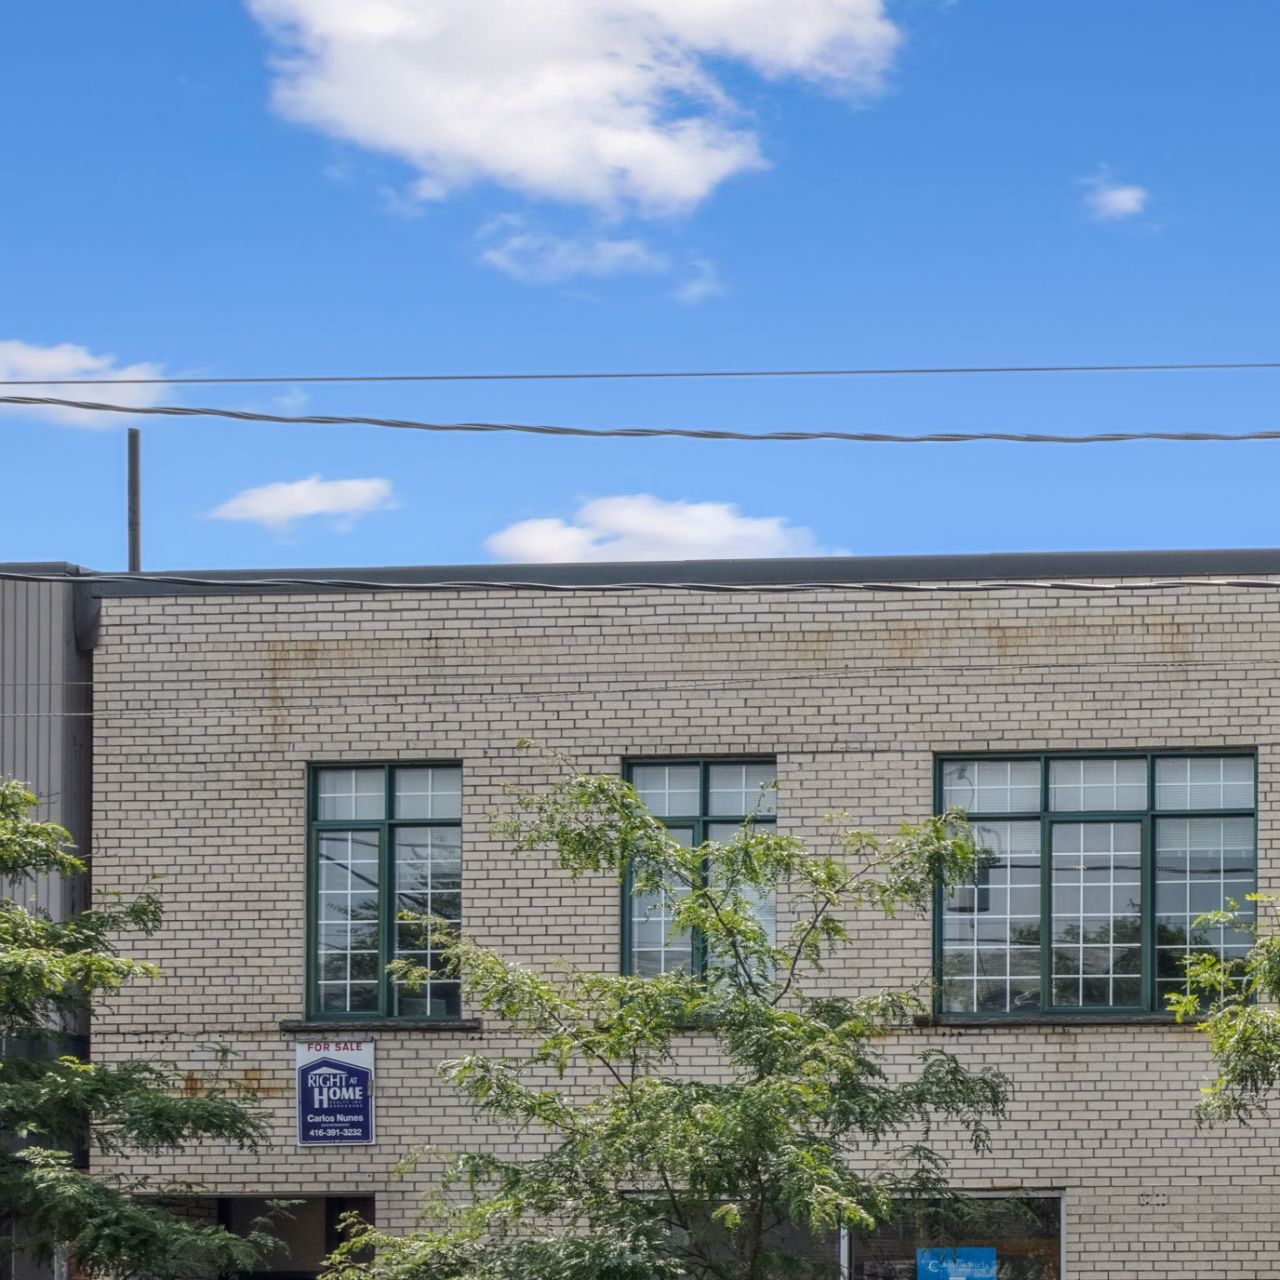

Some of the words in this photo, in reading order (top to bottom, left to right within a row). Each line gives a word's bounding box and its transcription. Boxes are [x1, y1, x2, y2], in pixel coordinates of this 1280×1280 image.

[307, 1042, 330, 1052] FOR
[335, 1041, 363, 1051] SALE
[308, 1074, 348, 1087] RIGHT
[349, 1077, 358, 1085] AT
[314, 1086, 363, 1108] HOME
[307, 1114, 335, 1122] Carlos
[336, 1113, 364, 1122] Nunes
[309, 1128, 362, 1137] 416-391-3232
